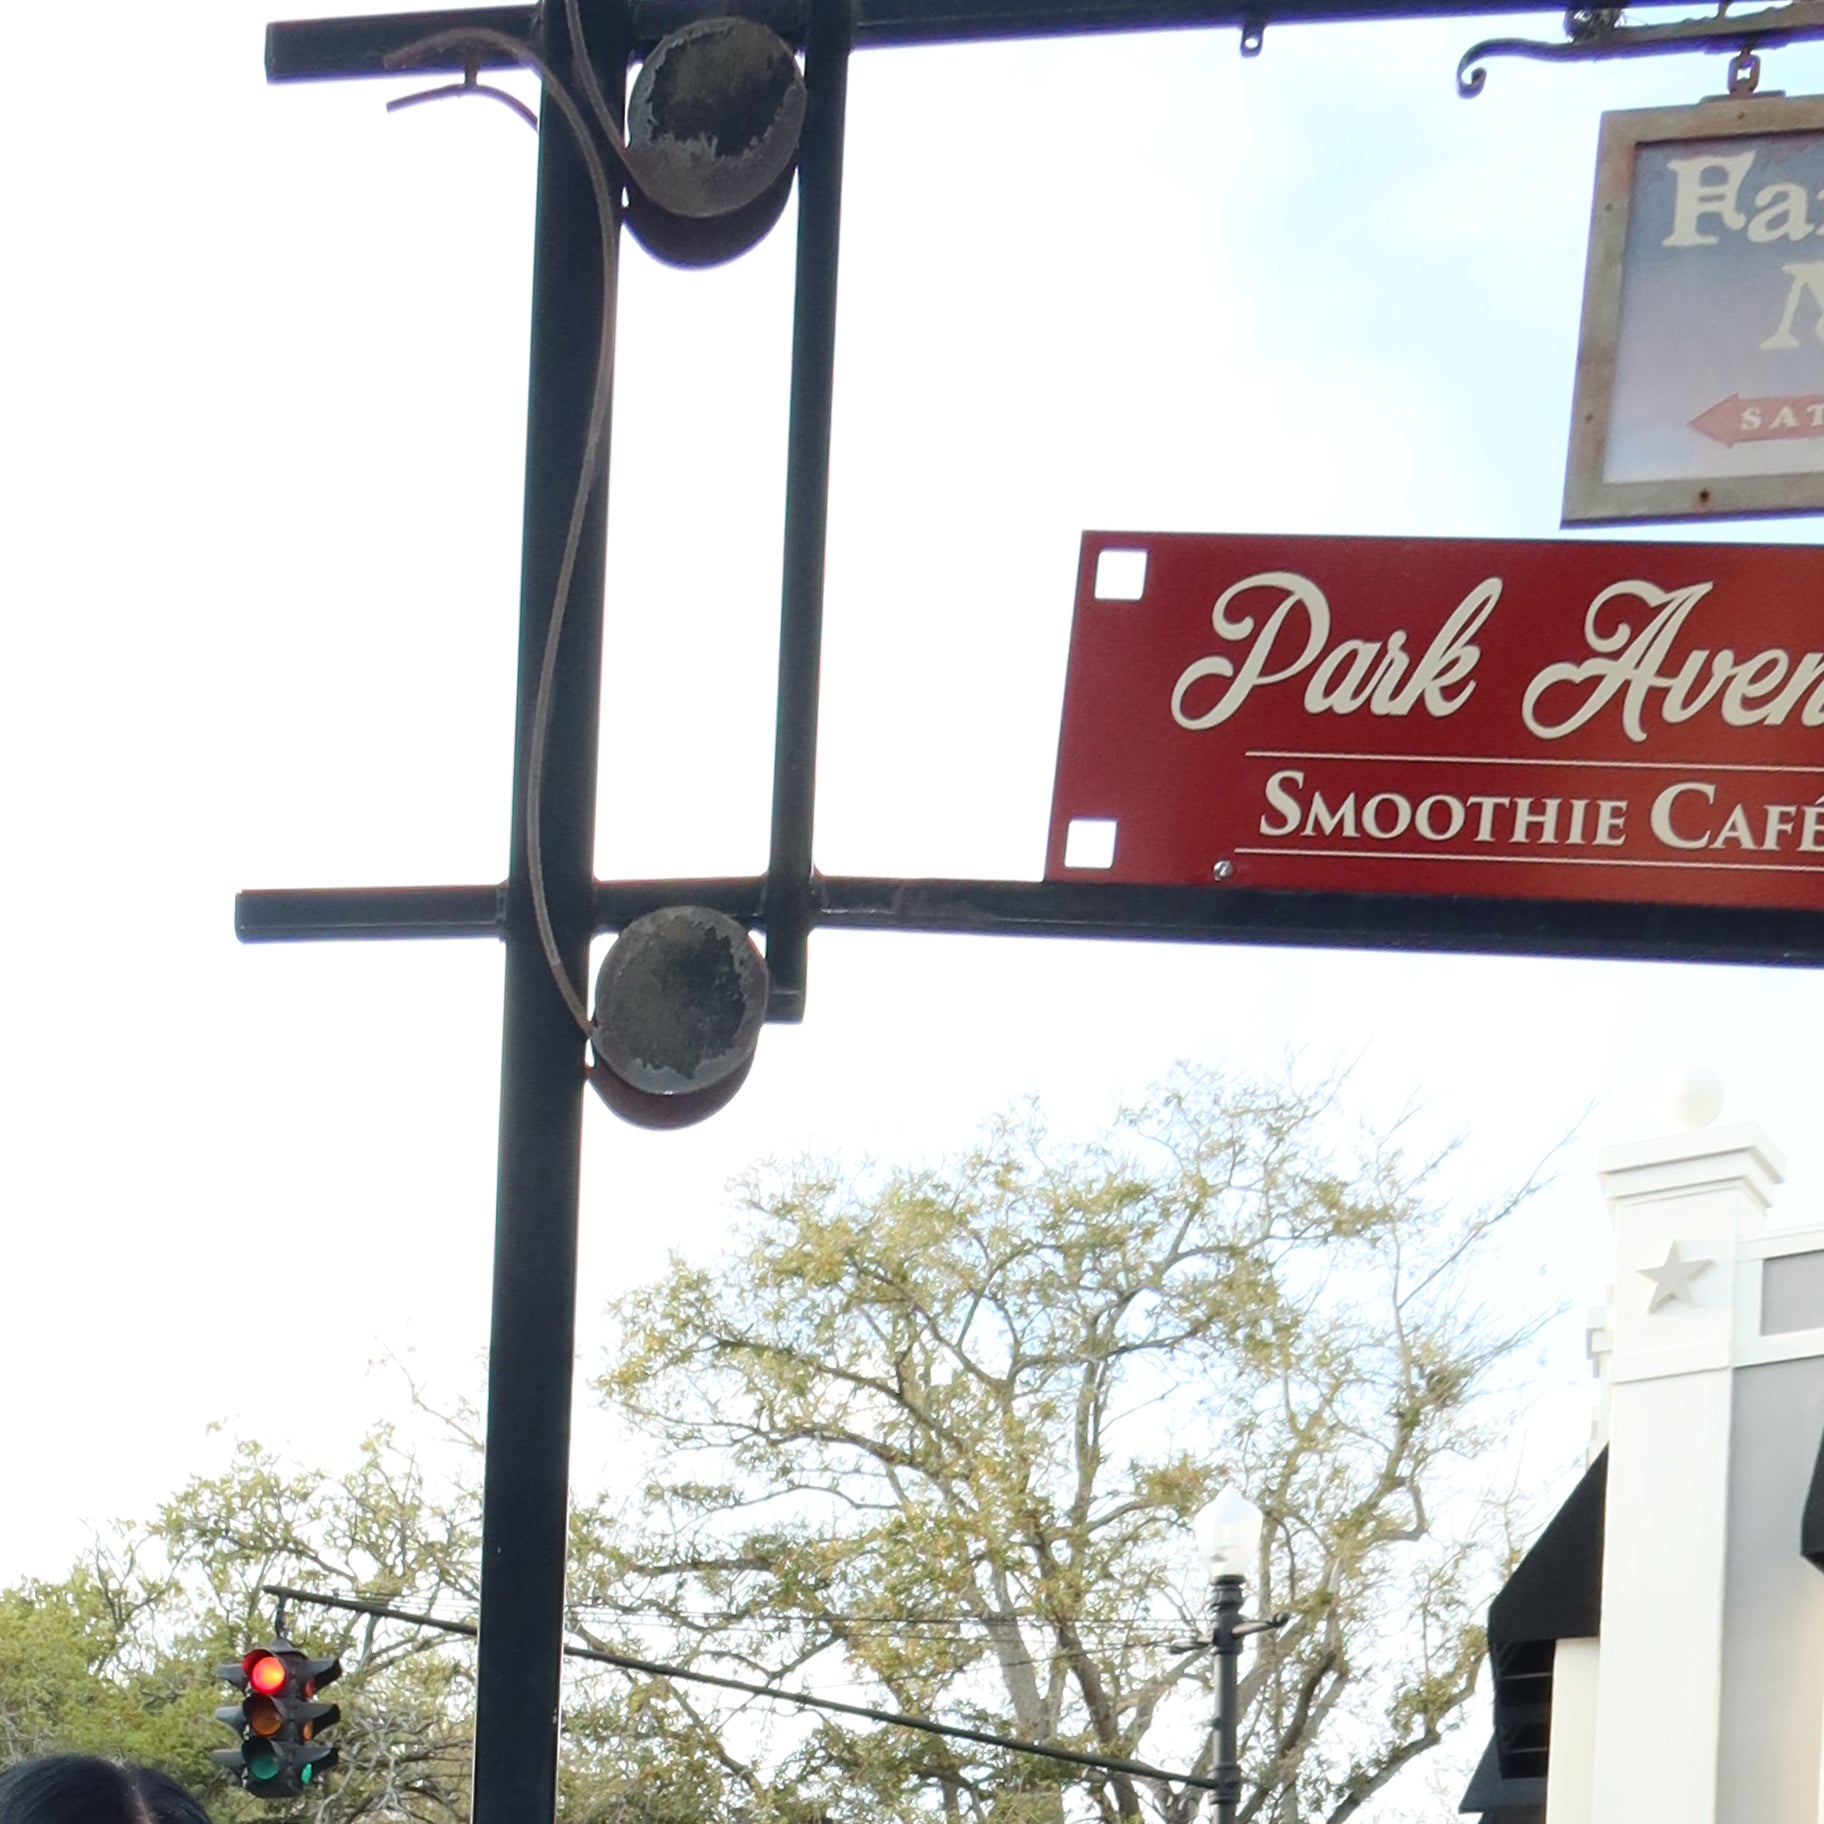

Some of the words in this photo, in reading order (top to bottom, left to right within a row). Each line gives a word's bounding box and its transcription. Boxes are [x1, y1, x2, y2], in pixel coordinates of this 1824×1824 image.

[1662, 150, 1824, 248] Fa
[1170, 569, 1505, 732] Park
[1259, 769, 1629, 848] SMOOTHIE
